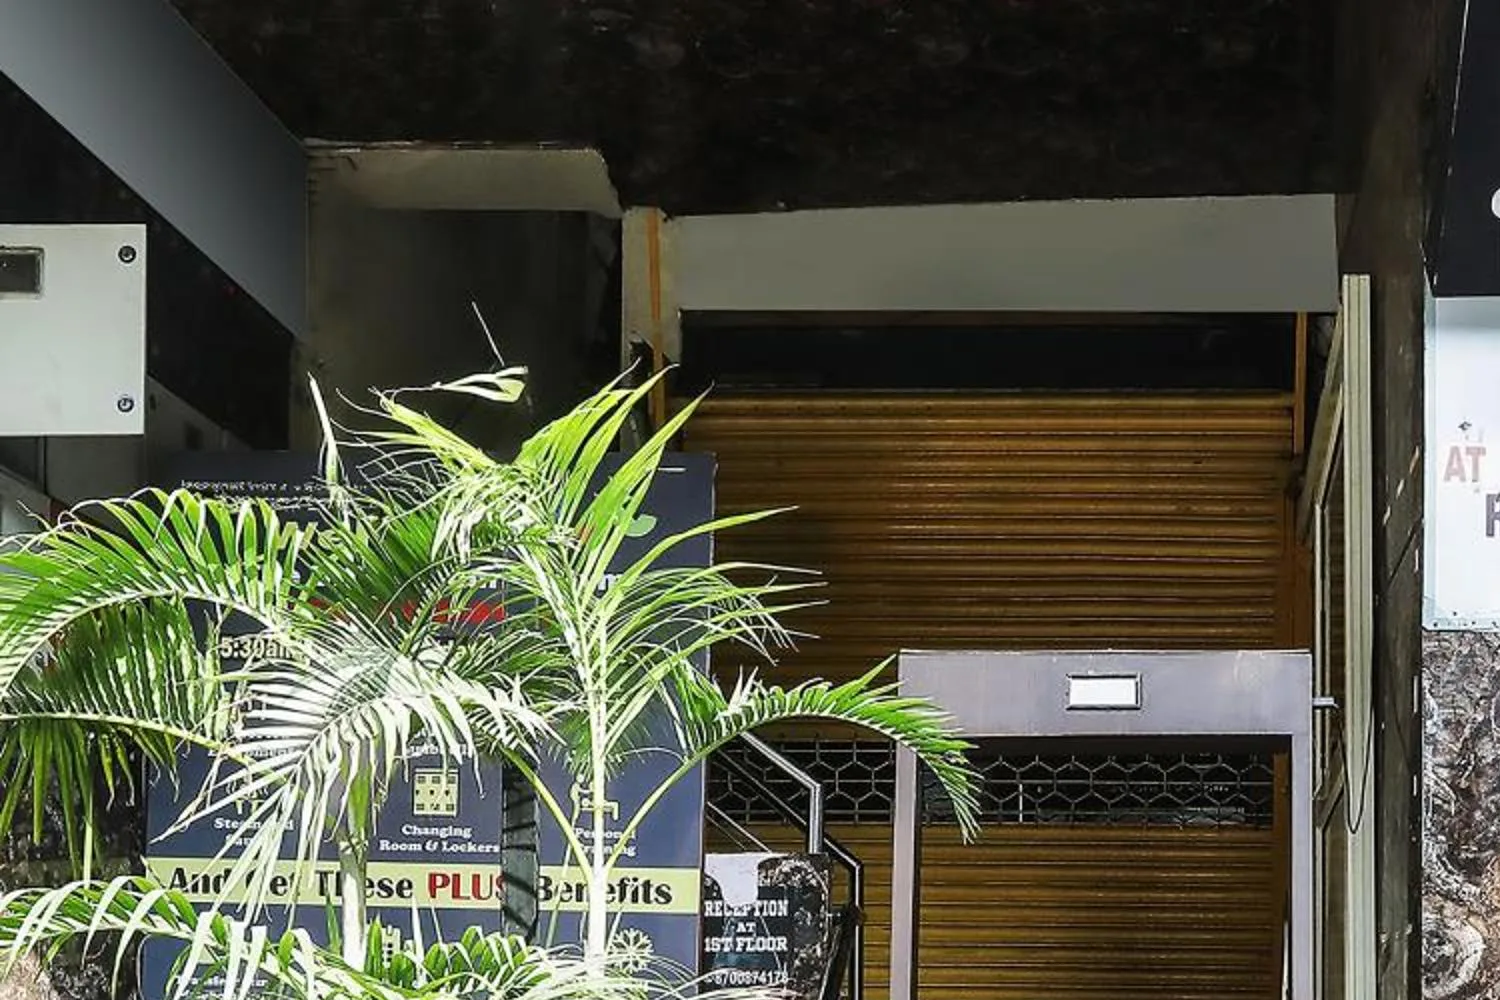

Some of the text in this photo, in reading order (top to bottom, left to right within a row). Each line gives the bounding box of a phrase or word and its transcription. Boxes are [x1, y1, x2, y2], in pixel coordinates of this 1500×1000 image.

[1444, 446, 1486, 483] AT
[401, 824, 472, 839] Changing
[379, 839, 423, 851] Room
[441, 840, 500, 853] Lockers
[736, 922, 757, 933] AT
[736, 935, 788, 951] FLOOR
